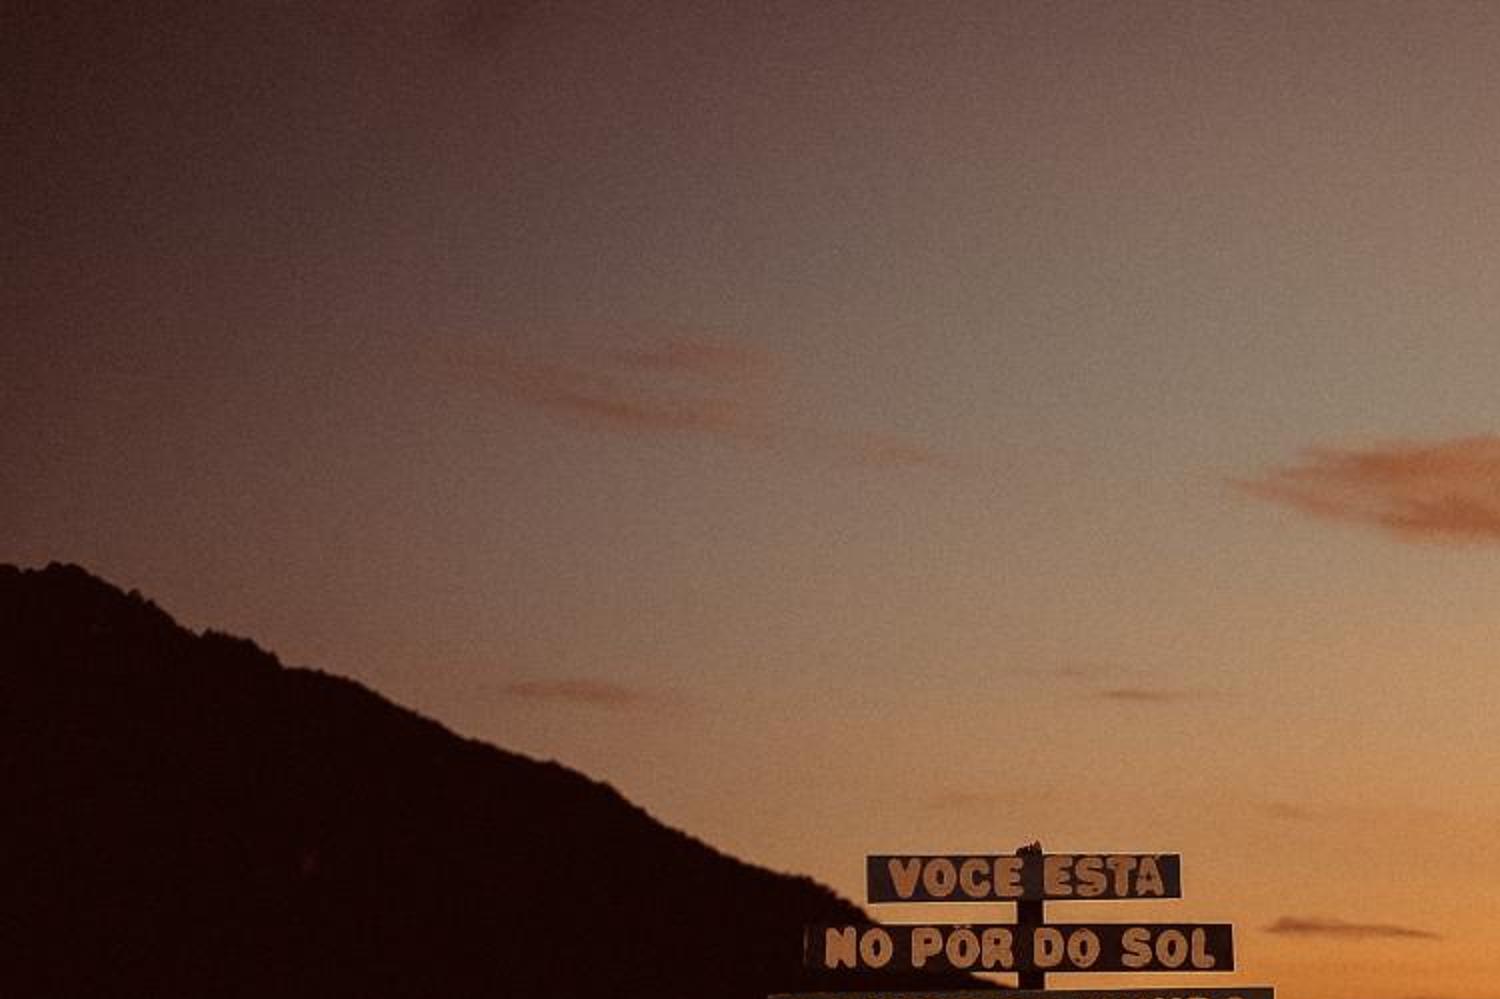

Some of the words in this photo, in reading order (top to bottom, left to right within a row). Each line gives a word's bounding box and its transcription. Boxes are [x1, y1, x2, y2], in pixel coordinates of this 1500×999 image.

[824, 926, 893, 970] NO
[1033, 928, 1100, 970] DO
[1121, 928, 1217, 969] SOL
